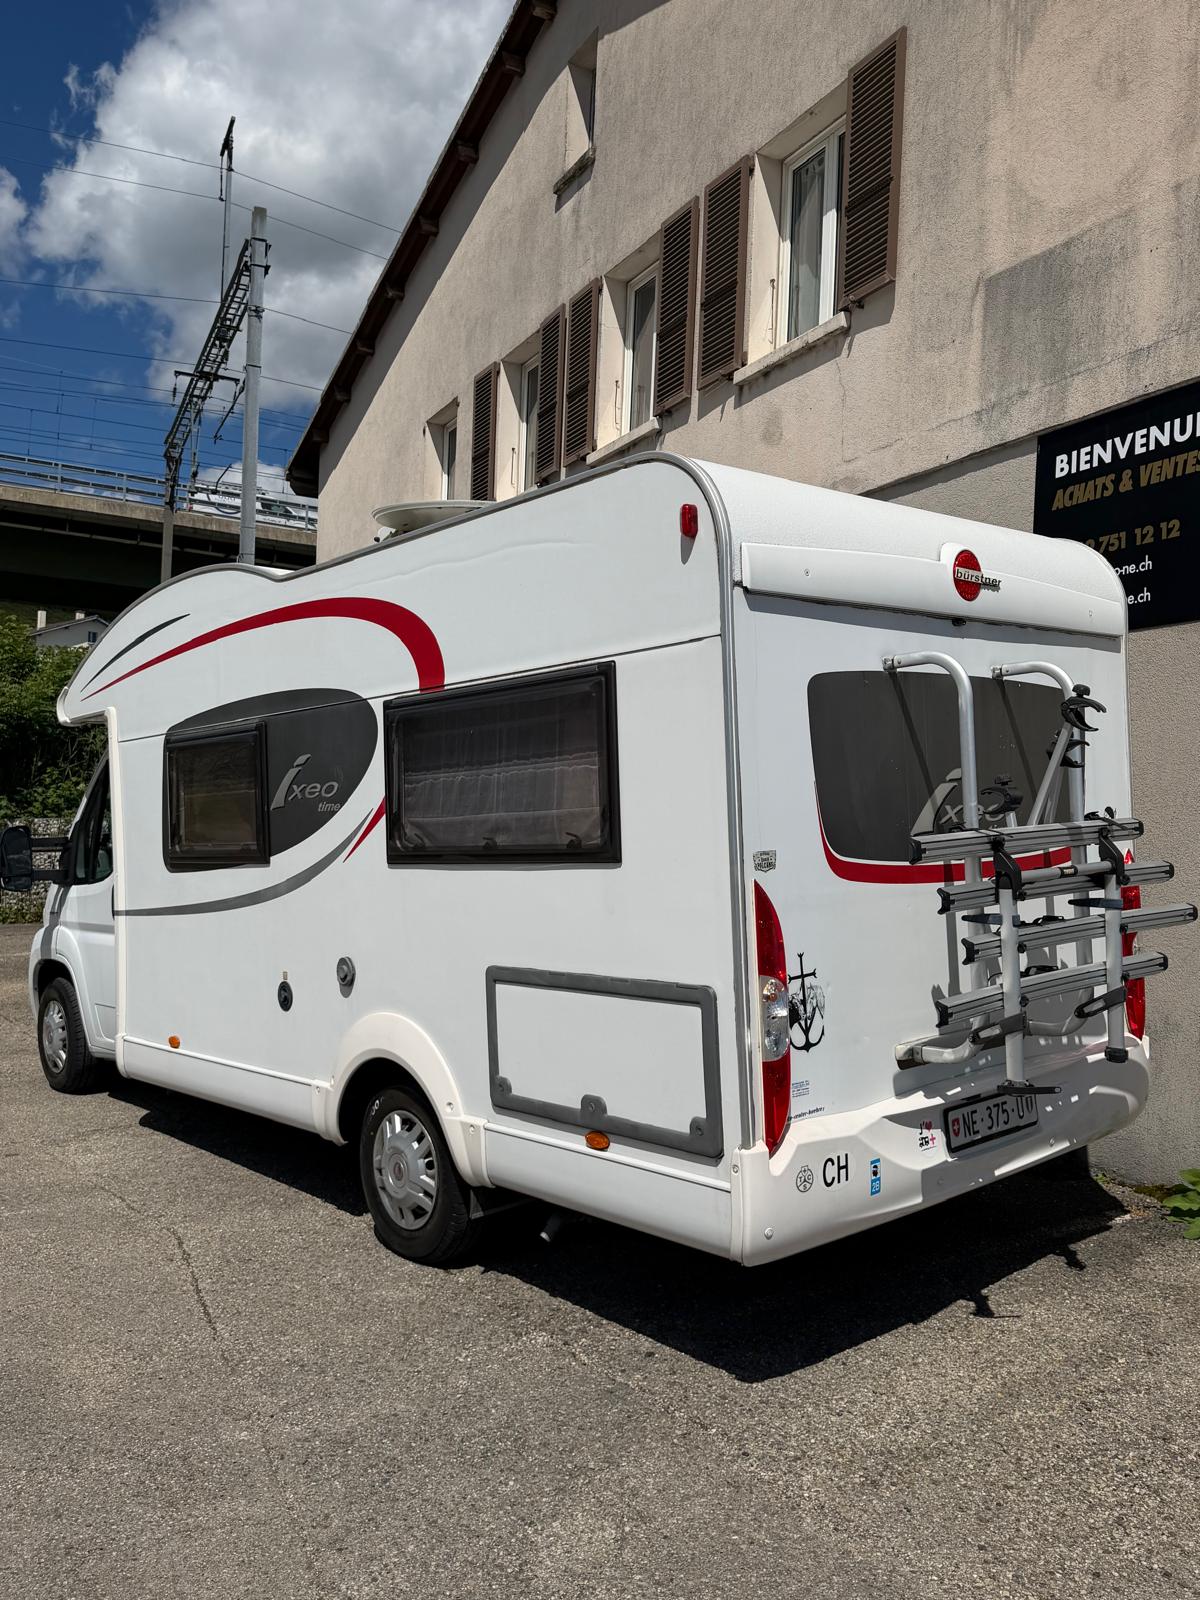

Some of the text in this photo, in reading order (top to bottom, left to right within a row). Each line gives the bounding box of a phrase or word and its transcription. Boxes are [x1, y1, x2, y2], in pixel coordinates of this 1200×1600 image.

[1051, 473, 1115, 511] ACHATS
[1118, 468, 1134, 493] &
[1098, 531, 1127, 555] 751
[1134, 525, 1155, 546] 12
[1160, 519, 1181, 540] 12
[956, 568, 1002, 586] bürstner
[318, 801, 341, 812] time
[822, 1153, 849, 1188] CH
